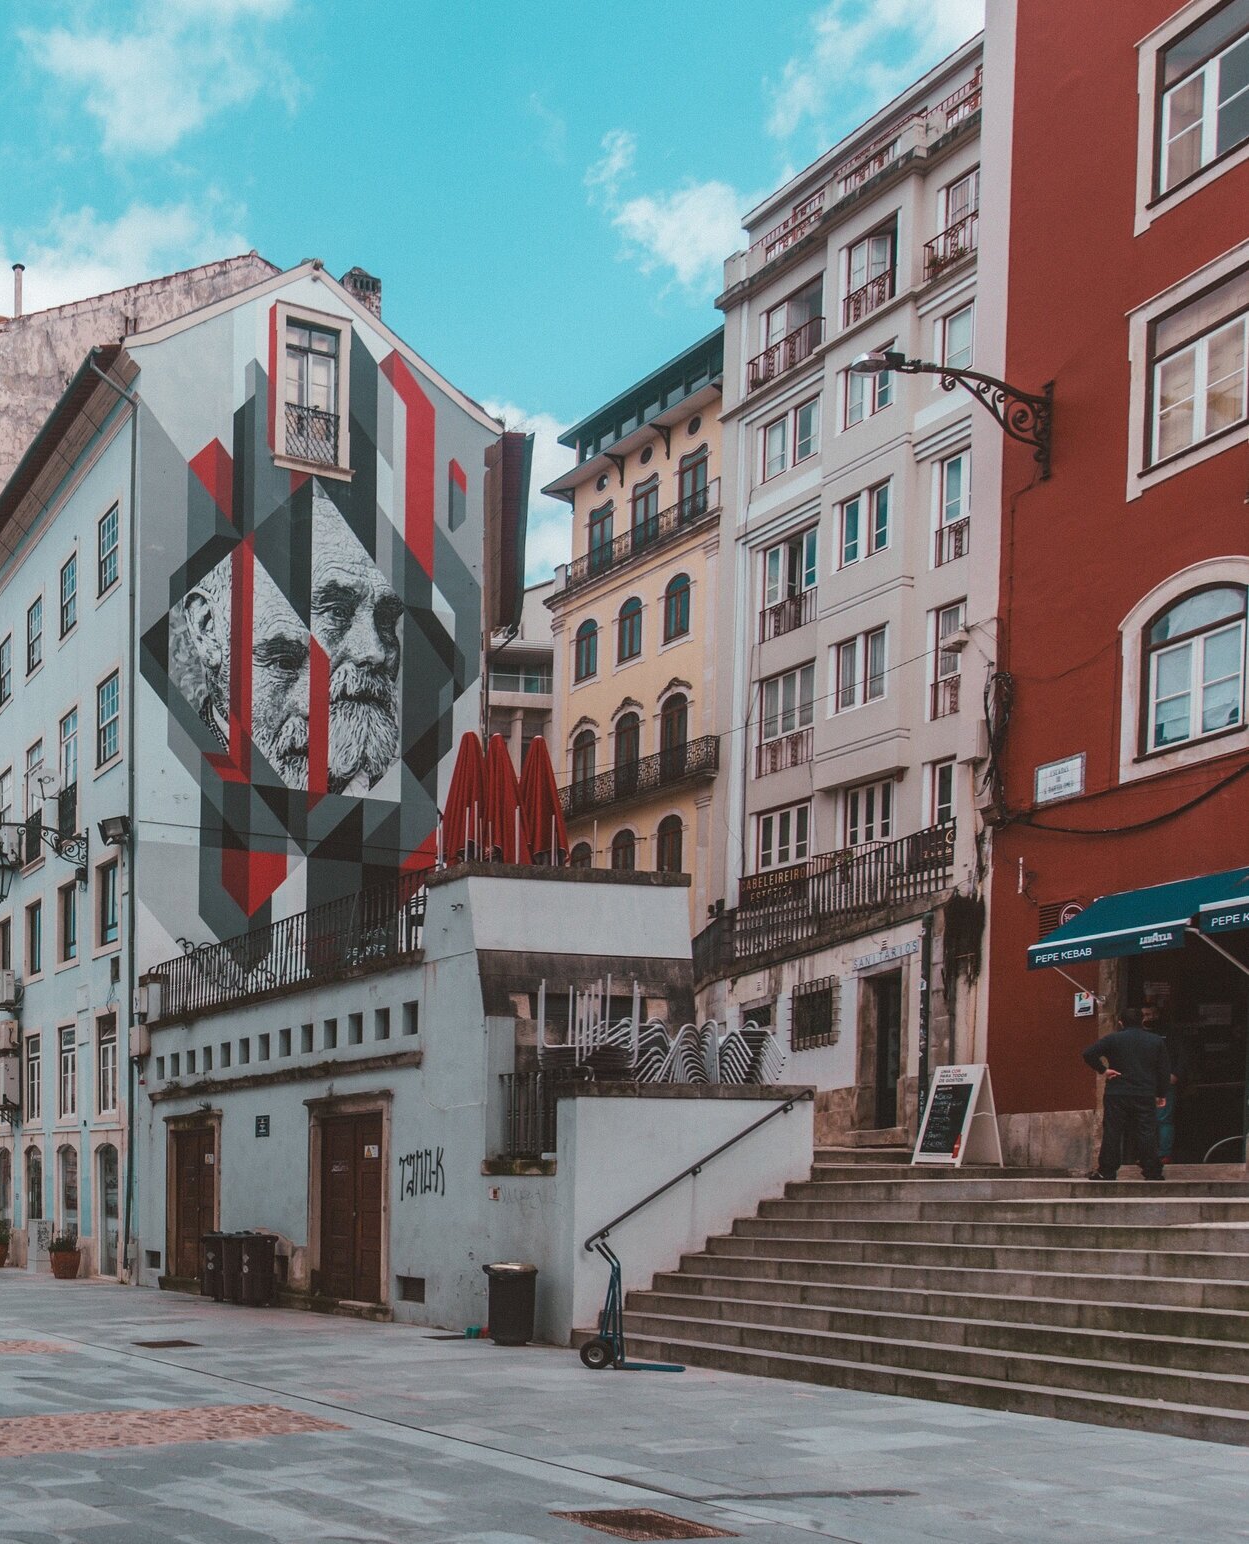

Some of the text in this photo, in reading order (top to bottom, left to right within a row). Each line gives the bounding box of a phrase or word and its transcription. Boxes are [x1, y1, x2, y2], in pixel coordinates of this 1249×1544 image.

[1211, 914, 1241, 927] PEPE
[1035, 947, 1092, 964] PEPE KEBAB
